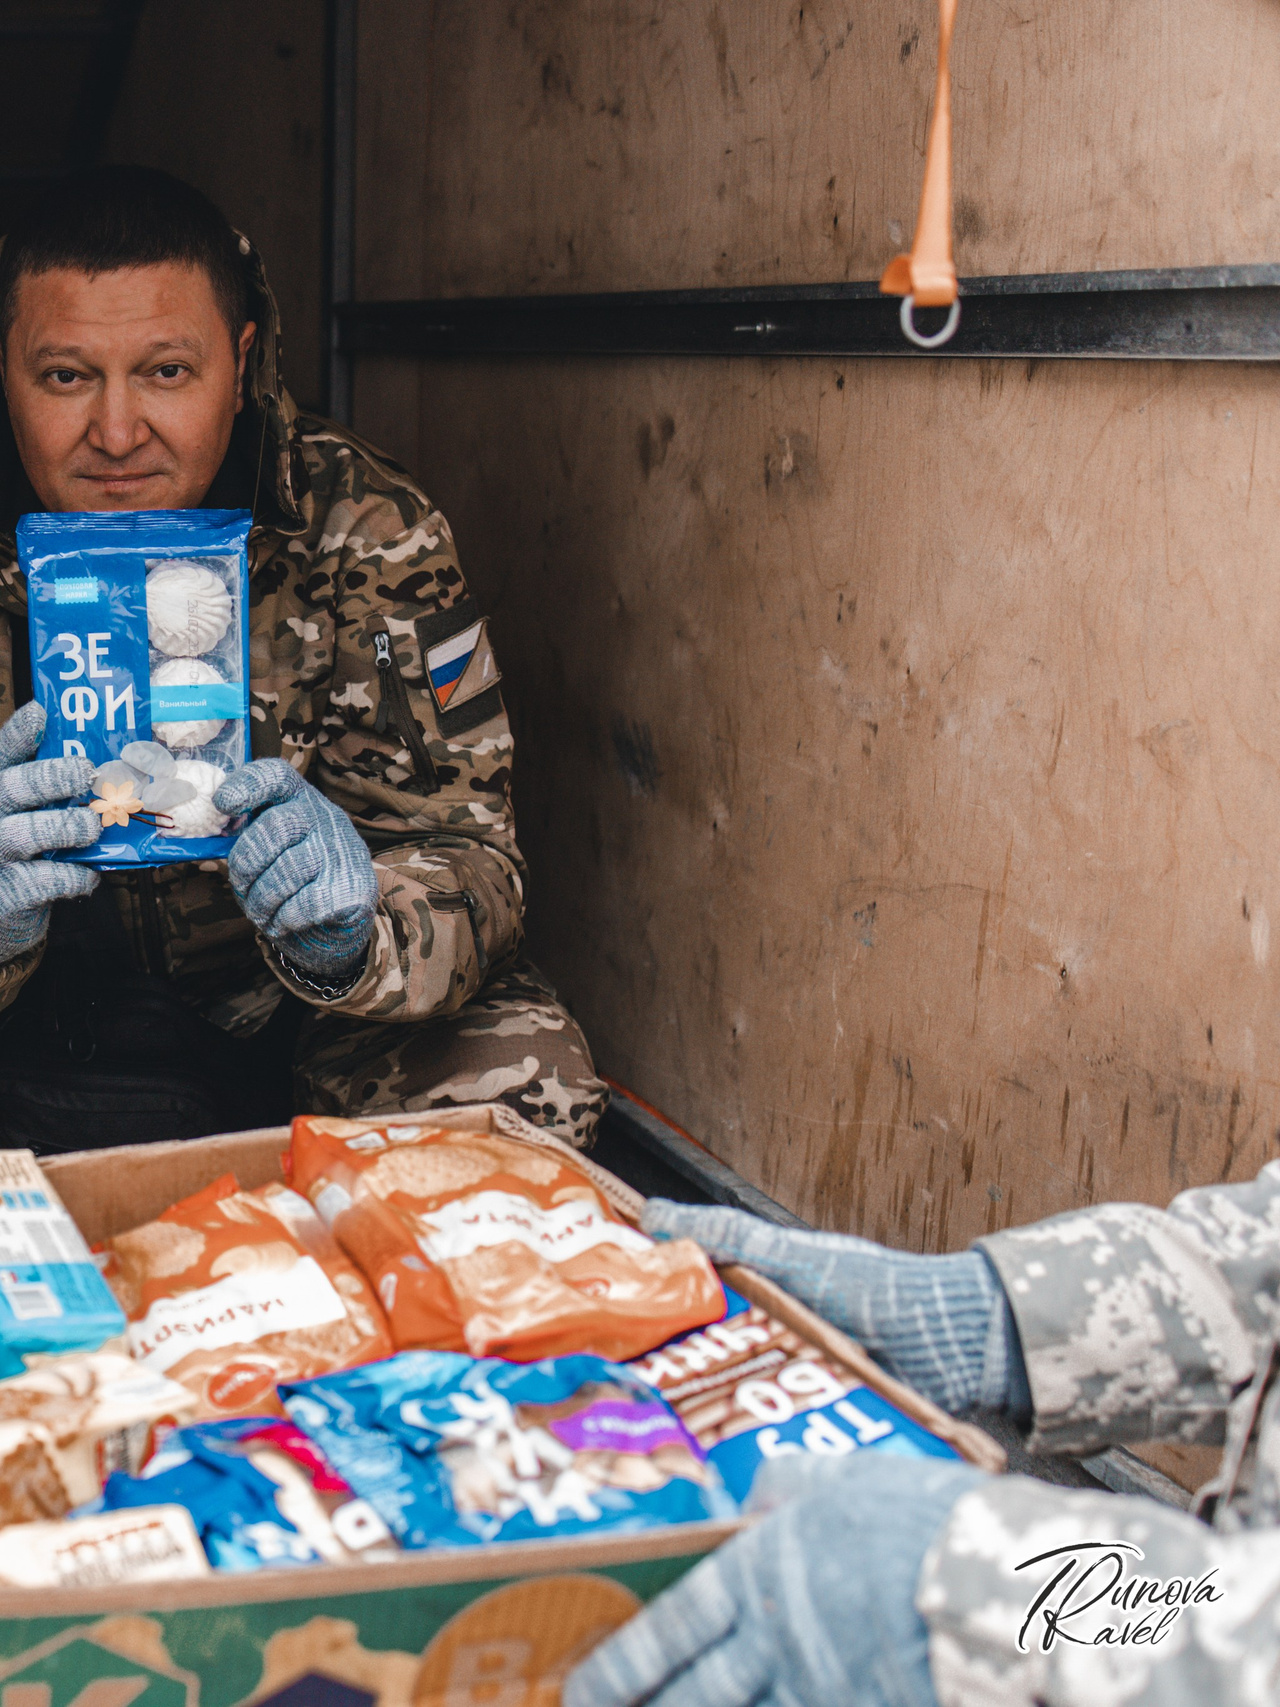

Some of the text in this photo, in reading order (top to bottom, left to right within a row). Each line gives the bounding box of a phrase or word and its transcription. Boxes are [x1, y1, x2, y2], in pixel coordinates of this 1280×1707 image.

[57, 632, 113, 681] ЗЕ
[60, 683, 136, 732] ФИ
[159, 699, 208, 709] Ванильный
